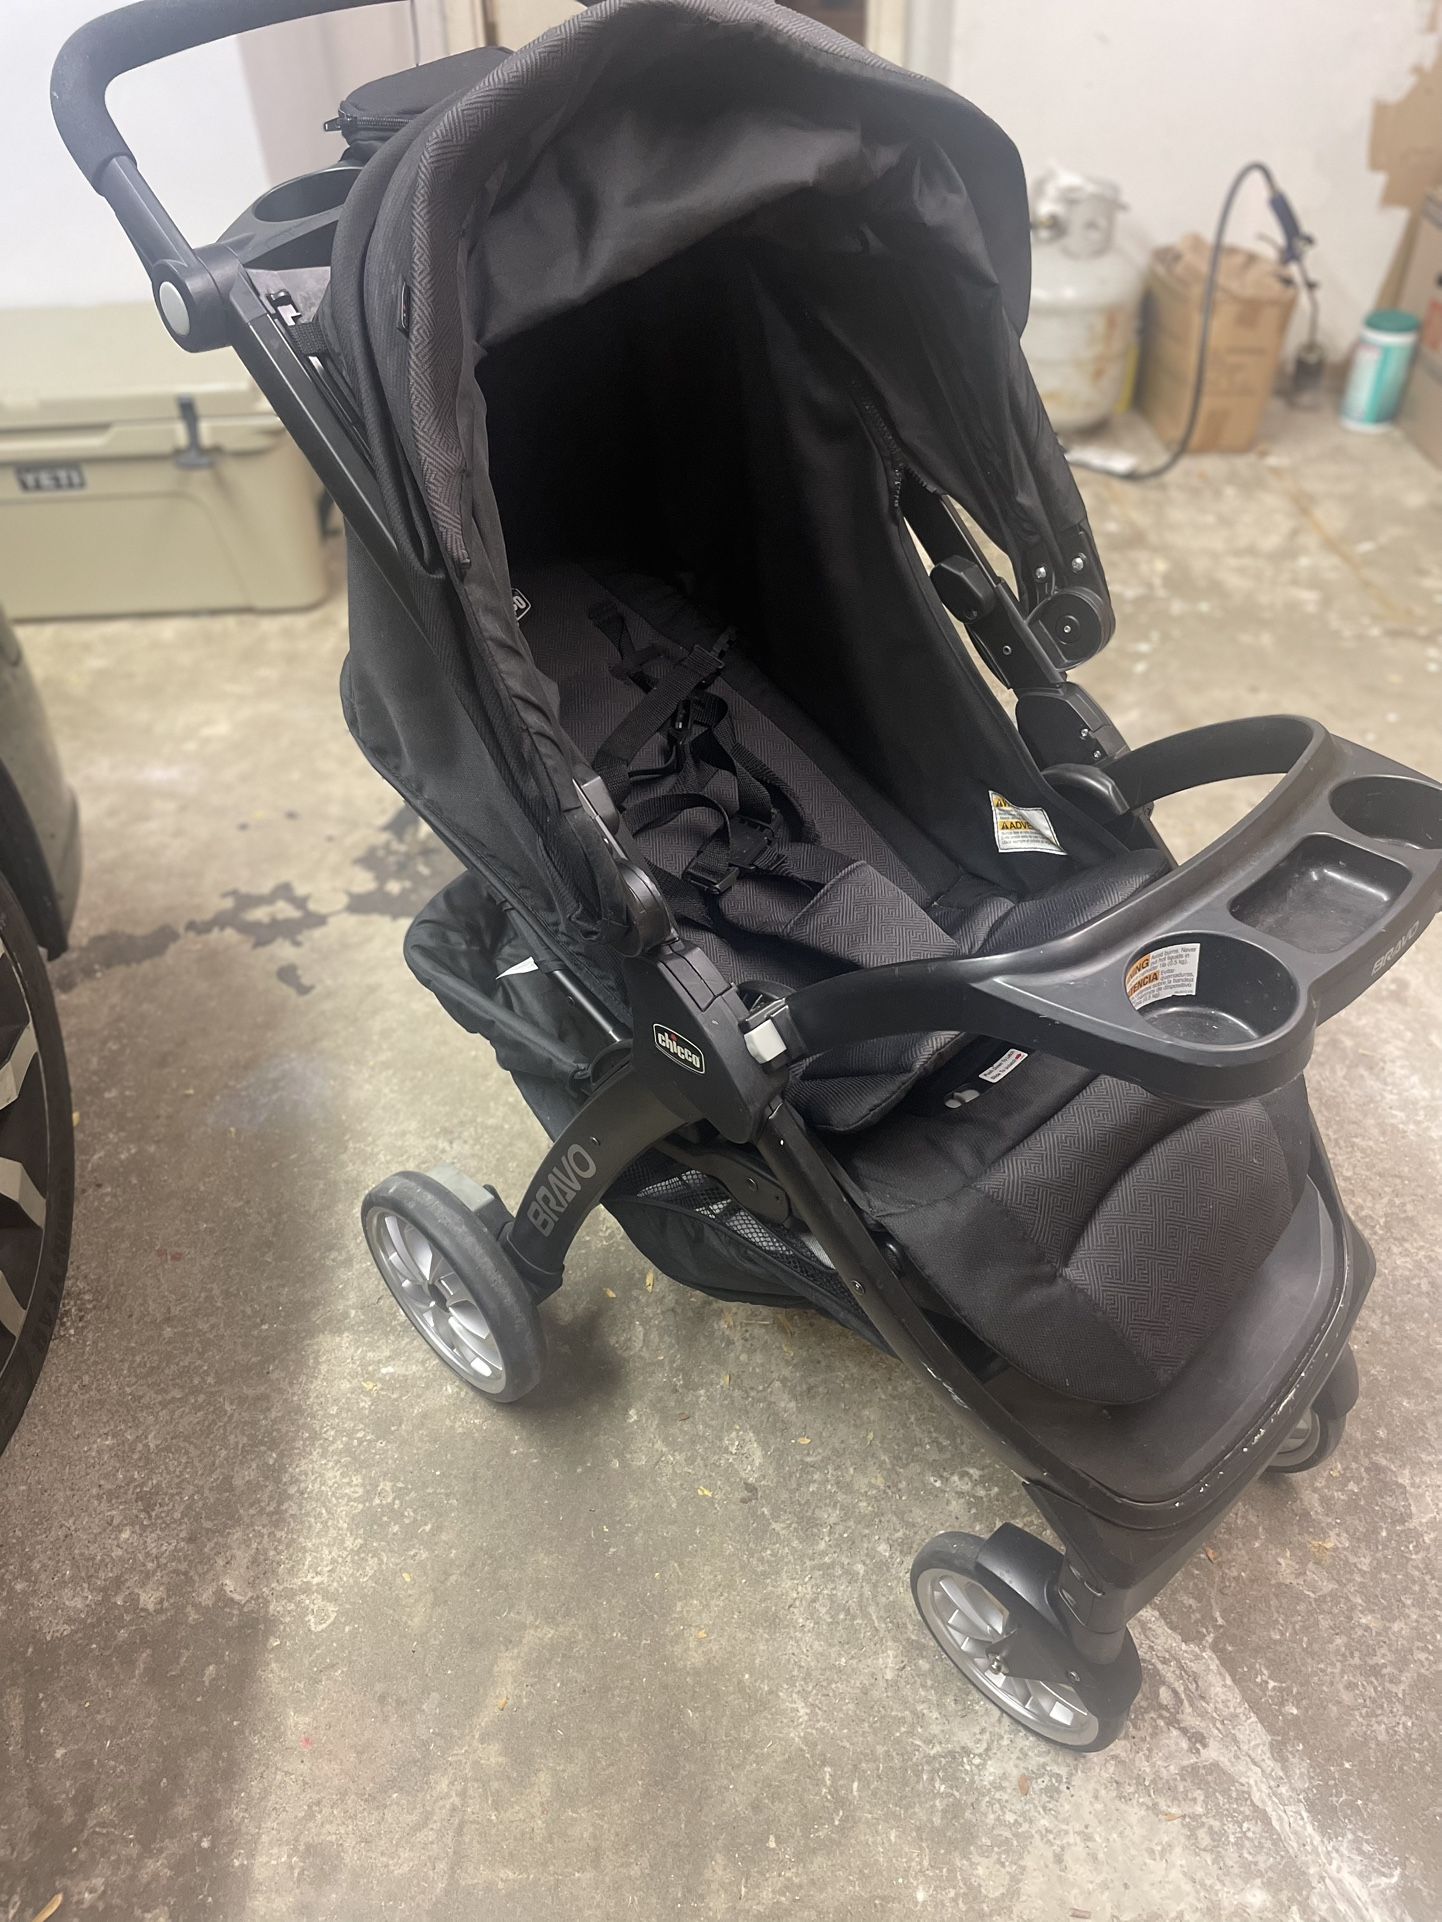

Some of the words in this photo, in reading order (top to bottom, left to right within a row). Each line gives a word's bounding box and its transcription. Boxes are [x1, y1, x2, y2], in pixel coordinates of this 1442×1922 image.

[21, 468, 81, 491] YETI
[1009, 821, 1033, 831] ADVE
[1371, 919, 1420, 977] BRAVO
[657, 1032, 701, 1068] chicco
[527, 1144, 597, 1237] BRAVO
